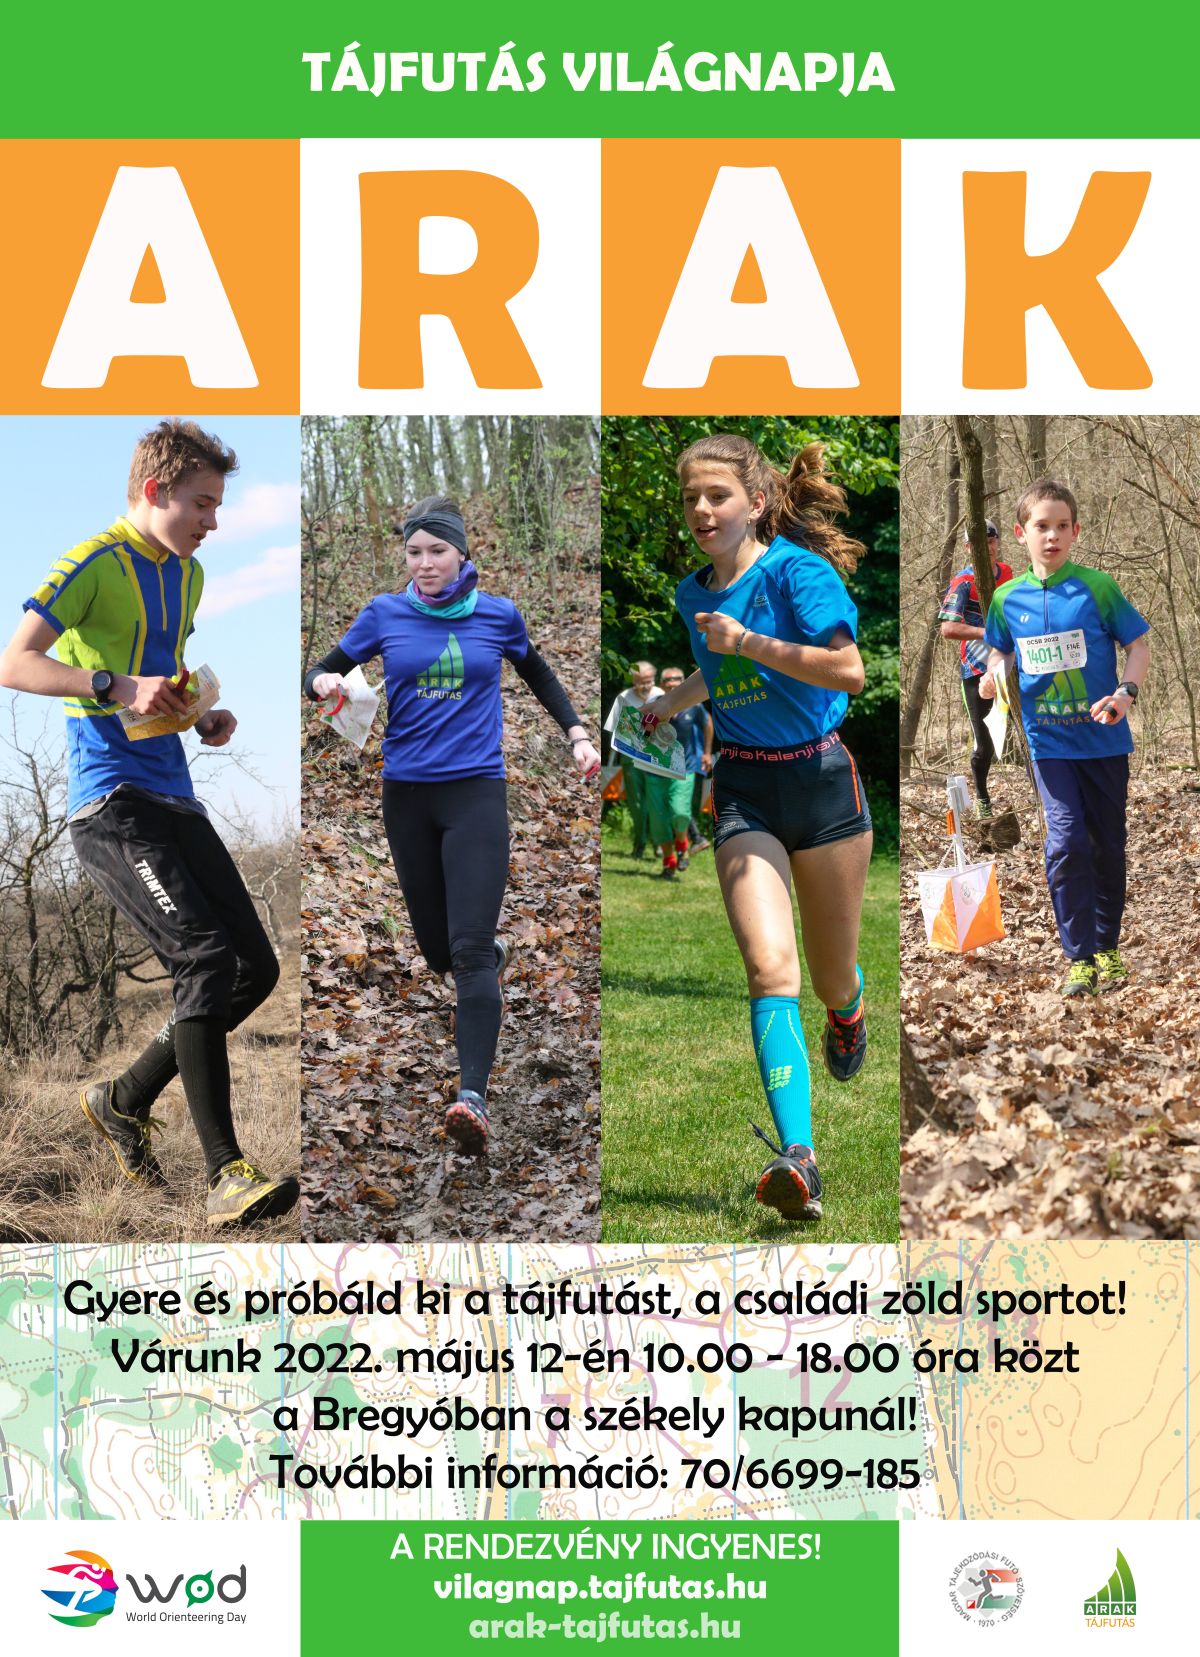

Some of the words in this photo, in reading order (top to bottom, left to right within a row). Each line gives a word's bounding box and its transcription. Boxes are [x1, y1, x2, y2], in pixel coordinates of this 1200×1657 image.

[302, 41, 546, 97] TÁJFUTÁS
[562, 41, 896, 97] VILÁGNAPJA
[1026, 645, 1063, 664] 1401-1
[417, 678, 463, 688] ARAK
[715, 676, 762, 698] ARAK
[1037, 702, 1087, 715] ARAK
[134, 859, 178, 915] TRIMTEX
[63, 1279, 181, 1322] Gyere
[193, 1281, 231, 1315] és
[244, 1279, 402, 1322] próbáld
[416, 1279, 451, 1315] ki
[464, 1290, 490, 1315] a
[502, 1279, 682, 1322] tájfutást,
[695, 1290, 721, 1315] a
[734, 1280, 868, 1315] családi
[881, 1279, 963, 1316] zöld
[976, 1280, 1126, 1322] sportot!
[111, 1338, 262, 1373] Várunk
[273, 1342, 382, 1374] 2022.
[396, 1338, 515, 1380] május
[526, 1338, 630, 1373] 12-én
[643, 1342, 753, 1373] 10.00
[796, 1342, 900, 1374] 18.00
[912, 1338, 979, 1373] óra
[994, 1337, 1080, 1373] közt
[273, 1406, 298, 1432] a
[313, 1396, 531, 1439] Bregyóban
[544, 1406, 570, 1432] a
[584, 1396, 725, 1439] székely
[738, 1396, 917, 1438] kapunál!
[268, 1453, 433, 1489] További
[447, 1452, 668, 1489] információ:
[681, 1454, 921, 1492] 70/6699-185
[389, 1532, 415, 1560] A
[424, 1526, 642, 1560] RENDEZVÉNY
[652, 1532, 821, 1560] INGYENES!
[433, 1571, 767, 1606] vilagnap.tajfutas.hu
[126, 1612, 157, 1622] World
[159, 1612, 224, 1625] Orienteering
[227, 1612, 247, 1624] Day
[978, 1619, 996, 1628] 1970
[1085, 1616, 1135, 1628] TÁJFUTÁS
[1086, 1604, 1135, 1614] ARAK
[468, 1611, 741, 1644] arak-tajfutas.hu
